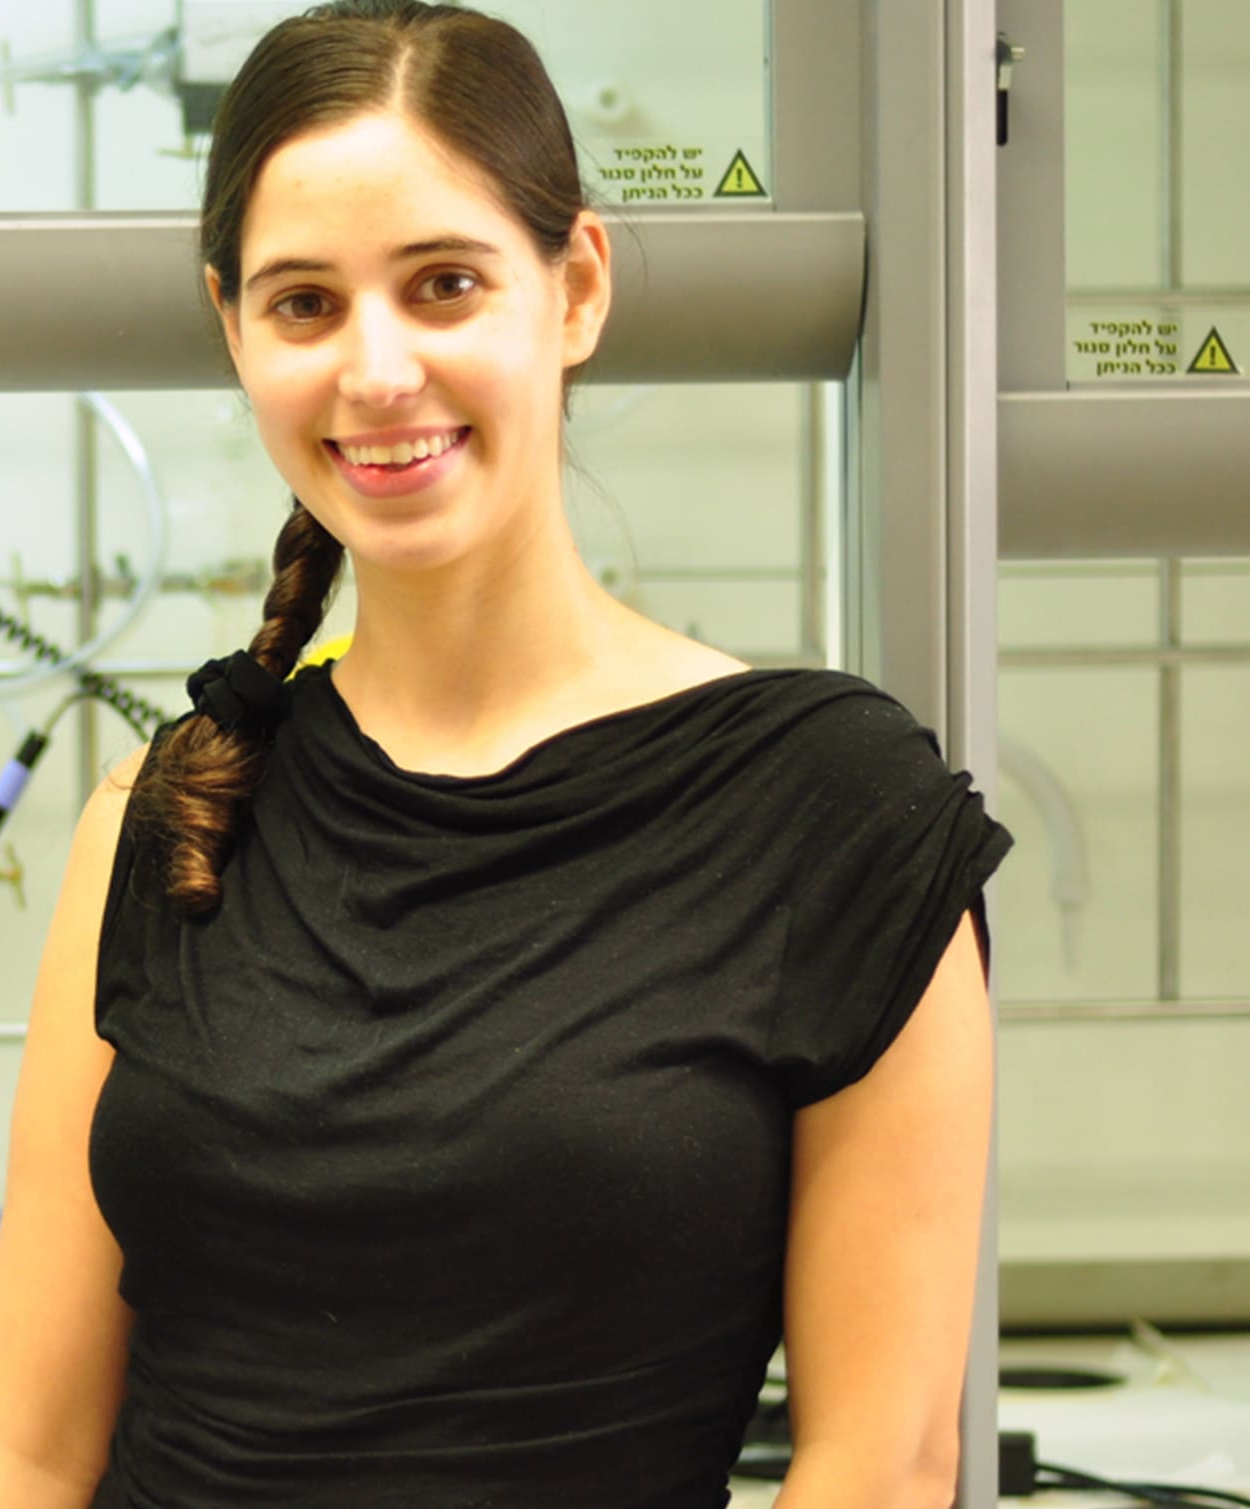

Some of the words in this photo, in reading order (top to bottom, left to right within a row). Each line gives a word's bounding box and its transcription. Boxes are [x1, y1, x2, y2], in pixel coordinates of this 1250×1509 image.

[614, 145, 677, 163] להקפיד
[683, 148, 703, 160] יש
[600, 167, 635, 180] סגור
[641, 164, 676, 183] חלון
[680, 164, 703, 180] על
[622, 186, 667, 202] הניתן
[672, 184, 703, 199] ככל
[1090, 320, 1152, 338] להקפיד
[1157, 325, 1177, 336] יש
[1074, 341, 1110, 354] סגור
[1115, 339, 1150, 357] חלון
[1154, 340, 1177, 355] על
[1097, 361, 1141, 376] הניתן
[1145, 360, 1176, 374] ככל
